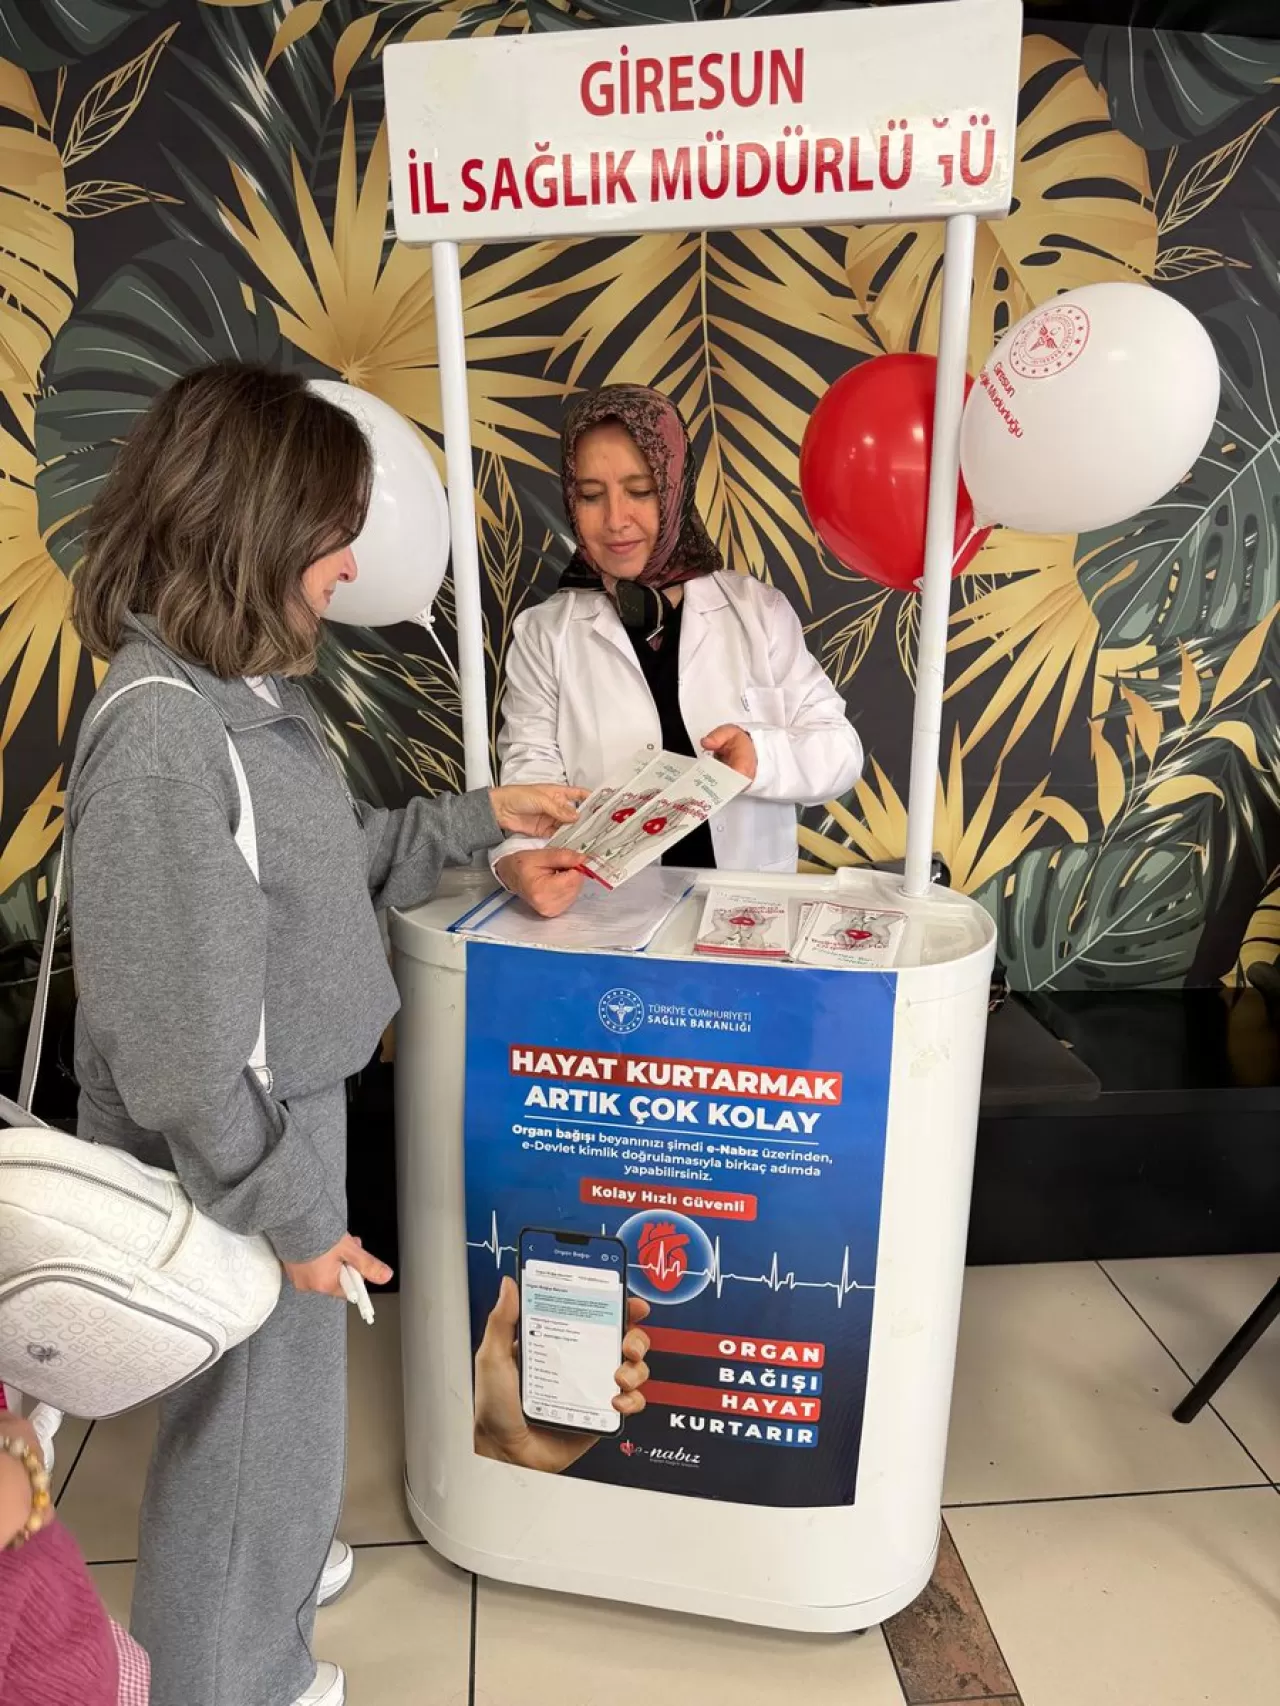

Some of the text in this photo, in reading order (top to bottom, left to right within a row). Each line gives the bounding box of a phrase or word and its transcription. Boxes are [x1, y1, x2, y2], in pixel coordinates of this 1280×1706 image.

[580, 45, 804, 117] GİRESUN
[408, 148, 449, 214] İL
[461, 141, 638, 213] SAĞLIK
[648, 1015, 751, 1032] SAĞLIK BAKANLIĞI
[649, 1004, 751, 1021] TÜRKİYE CUMHURİYETİ
[512, 1050, 839, 1100] HAYAT KURTARMAK
[524, 1085, 822, 1133] ARTIK ÇOK KOLAY
[512, 1124, 833, 1165] Organ bağışı beyanınızı şimdi e-Nabız üzerinden,
[522, 1140, 821, 1176] e-Devlet kimlik doğrulamasıyla birkaç adımda
[624, 1164, 713, 1181] yapabilirsiniz.
[592, 1185, 745, 1212] Kolay Hızlı Güvenli
[718, 1339, 819, 1363] ORGAN
[719, 1367, 817, 1393] BAĞIŞI
[722, 1394, 816, 1416] HAYAT
[670, 1413, 813, 1443] KURTARIR
